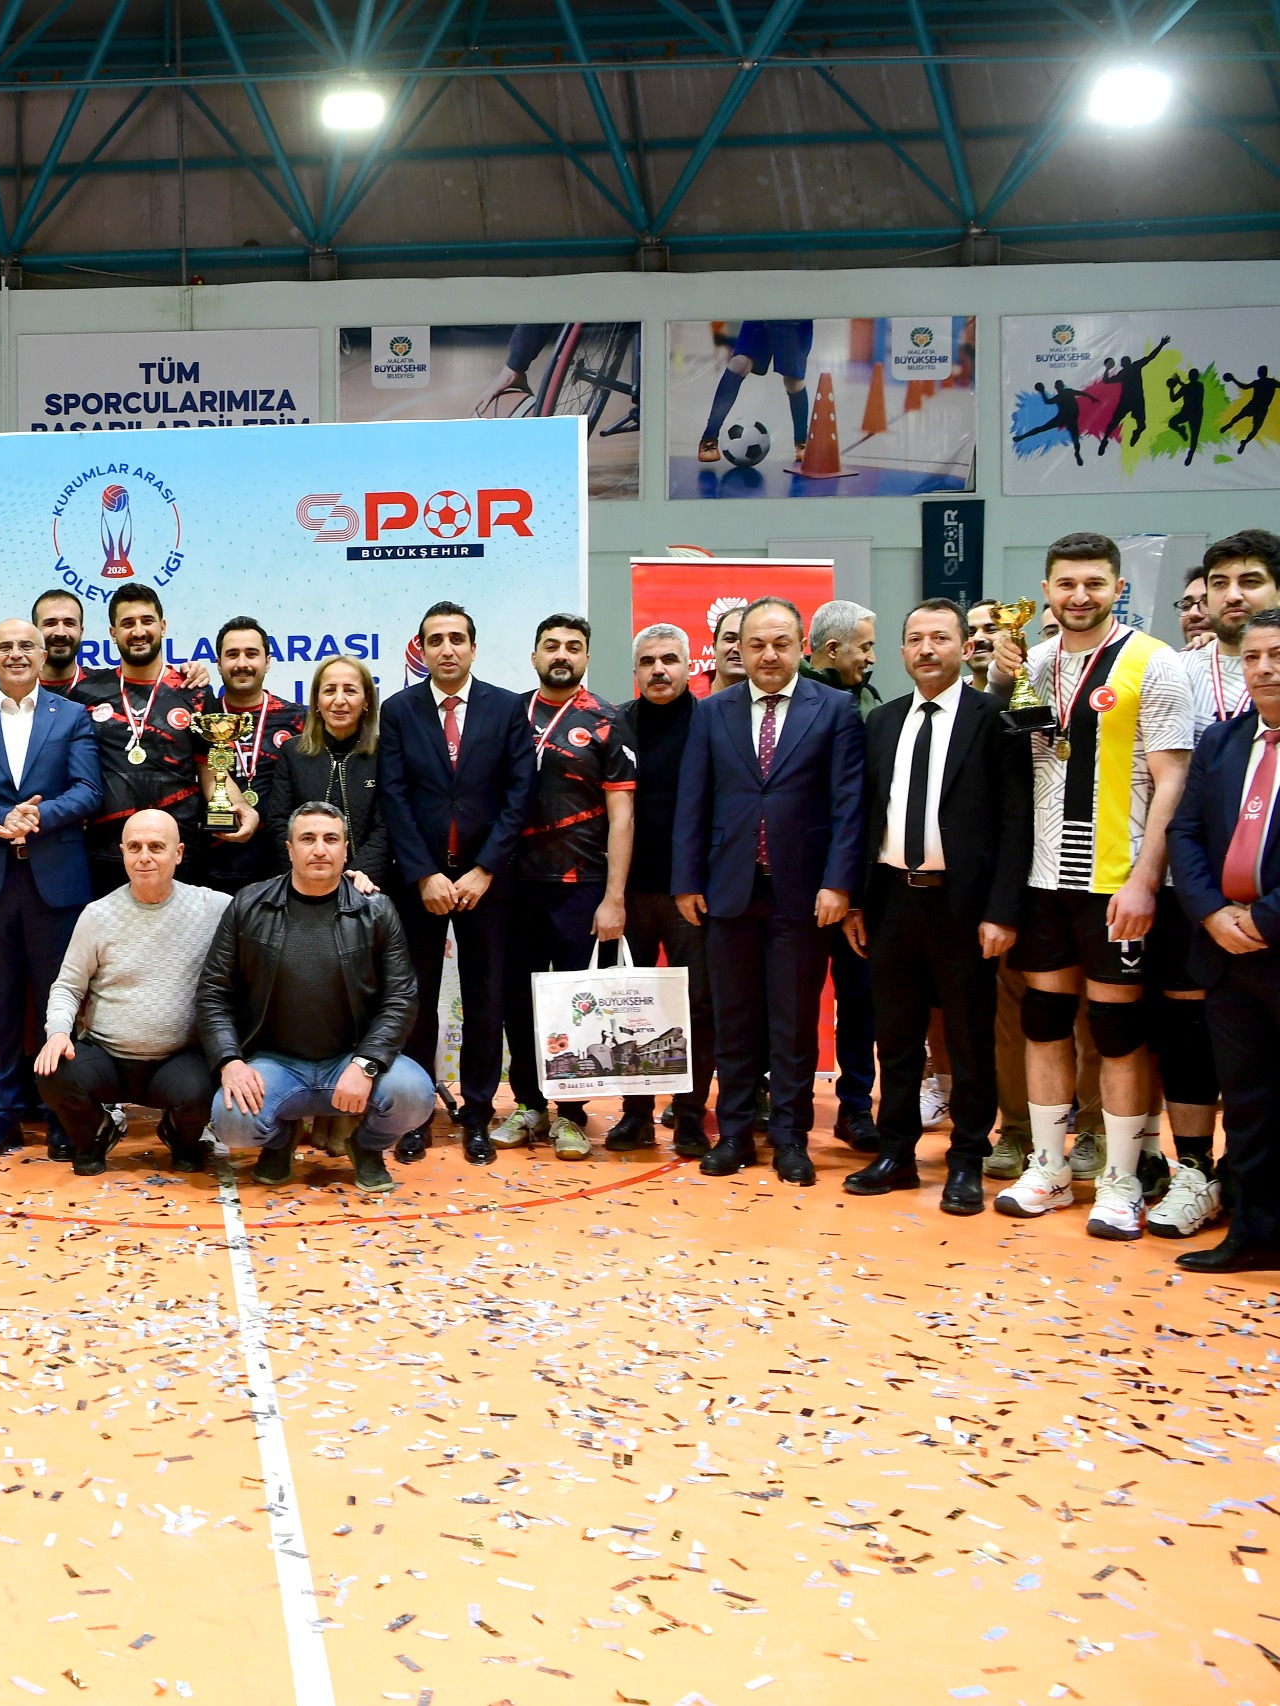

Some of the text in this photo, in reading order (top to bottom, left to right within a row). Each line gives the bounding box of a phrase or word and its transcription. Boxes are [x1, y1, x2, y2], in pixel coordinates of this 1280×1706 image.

[139, 356, 200, 384] TÜM
[44, 388, 296, 416] SPORCULARIMIZA
[52, 463, 176, 517] KURUMLAR ARASI
[362, 545, 470, 559] BÜYÜKŞEHİR
[54, 556, 118, 604] VOLEY
